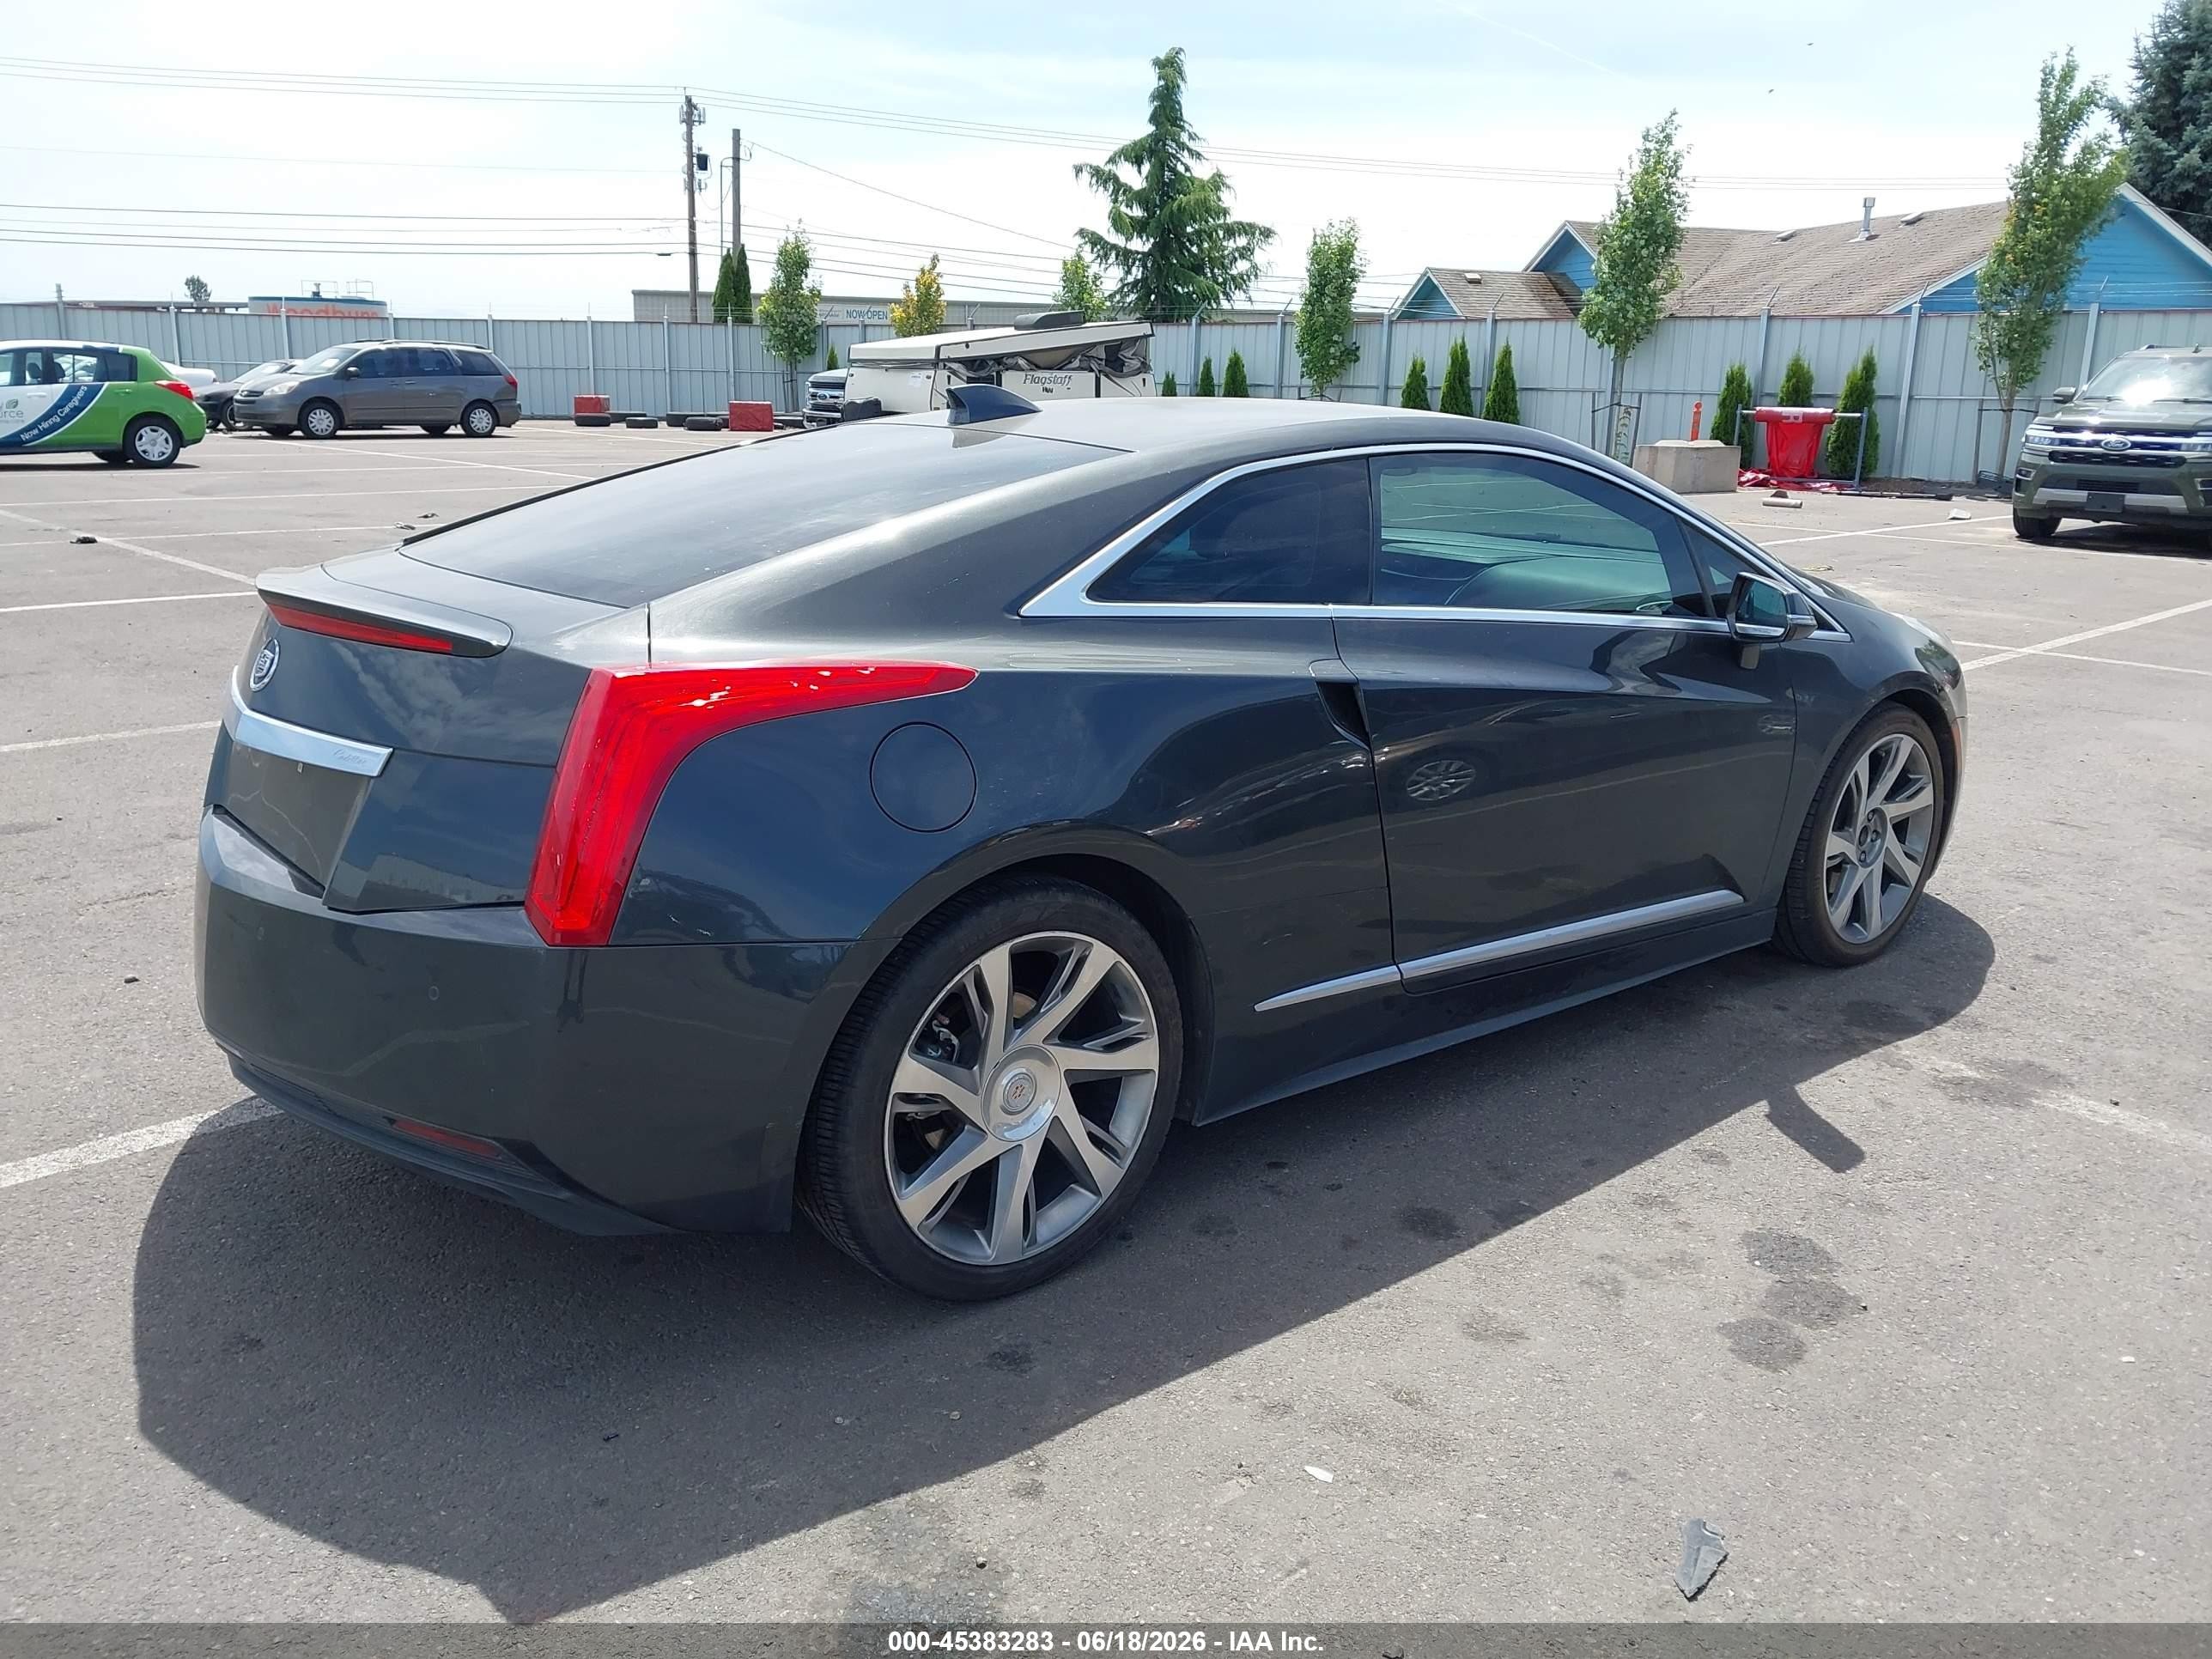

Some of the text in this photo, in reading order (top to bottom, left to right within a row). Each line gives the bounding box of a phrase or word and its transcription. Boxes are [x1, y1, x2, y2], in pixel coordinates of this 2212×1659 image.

[846, 309, 865, 319] NOW
[866, 310, 888, 320] OPEN
[1023, 374, 1073, 386] Flagstaff
[20, 428, 39, 441] Now
[57, 385, 88, 416] Caregivers
